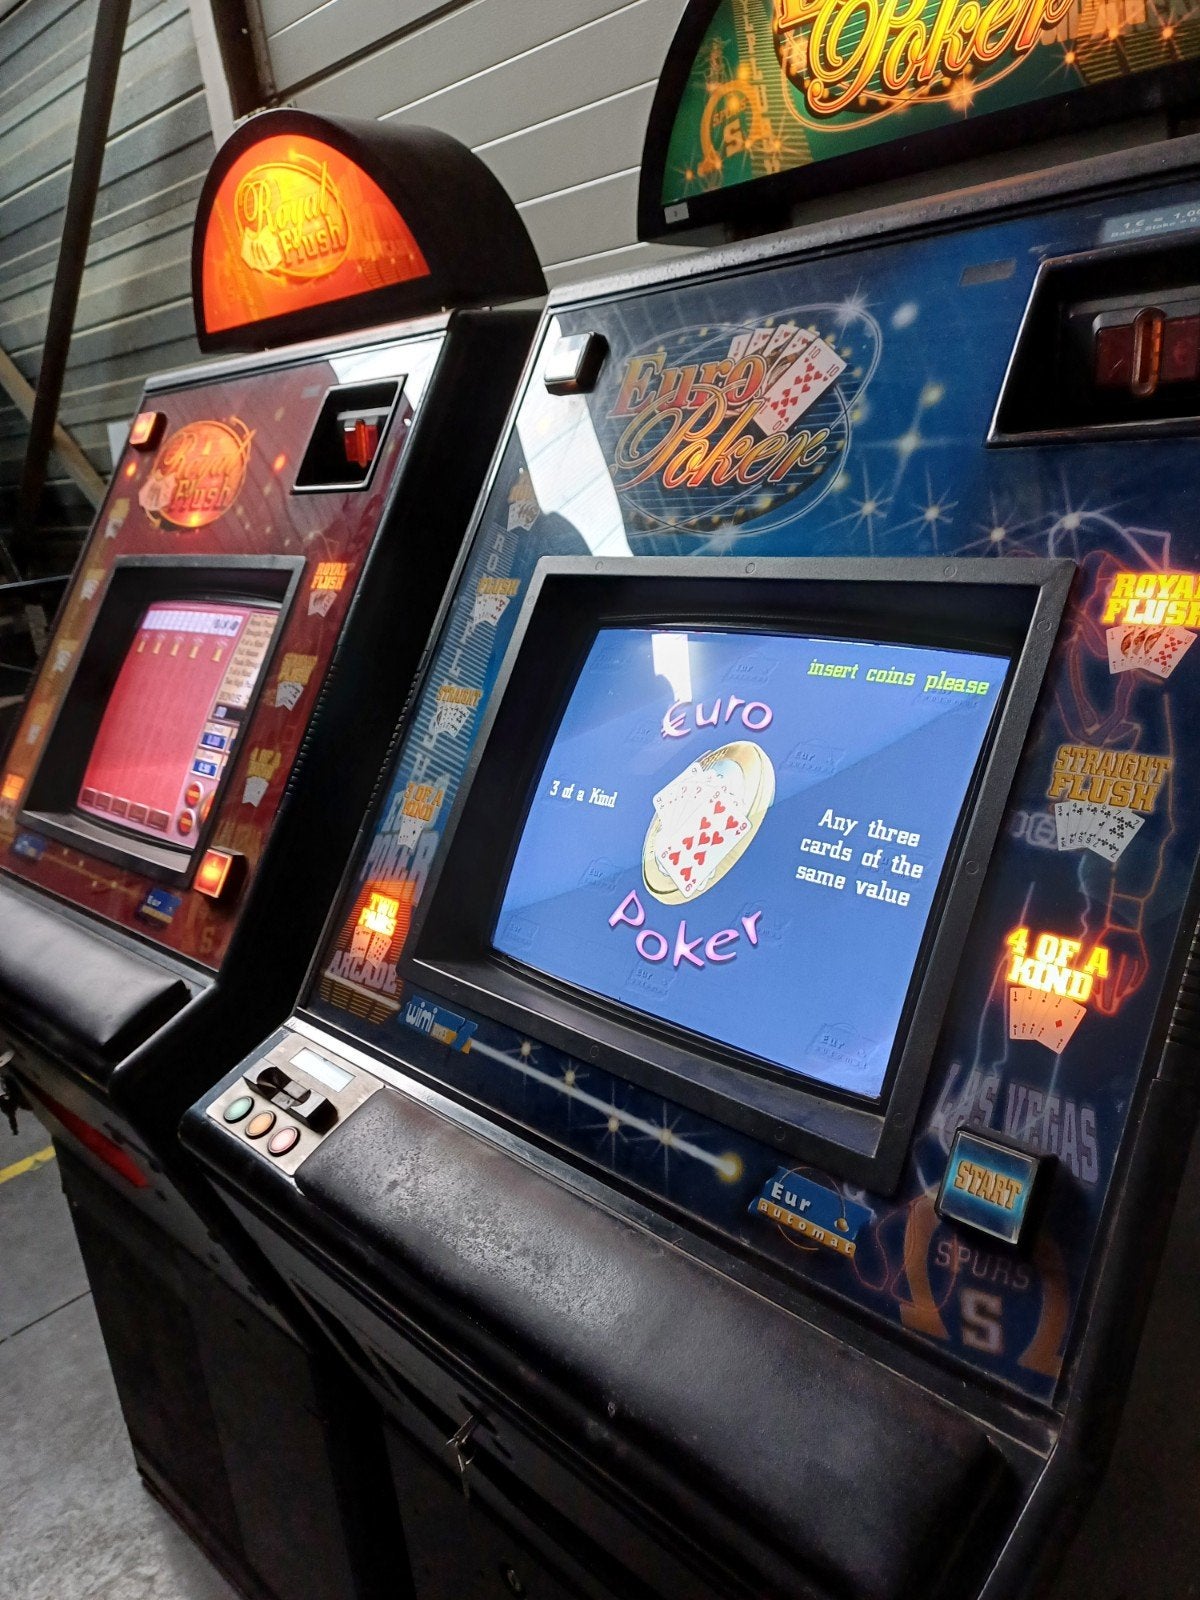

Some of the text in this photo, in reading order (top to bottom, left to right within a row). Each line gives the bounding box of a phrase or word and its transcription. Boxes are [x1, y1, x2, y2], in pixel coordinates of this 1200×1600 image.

[807, 0, 1072, 114] Poker
[606, 352, 767, 419] Euro
[610, 383, 832, 491] Poker
[1112, 574, 1200, 599] ROYA
[807, 659, 990, 695] insert coins please
[1054, 746, 1172, 784] STRAIGHT
[402, 799, 434, 821] KIND
[404, 782, 444, 807] 3 OF A
[549, 780, 618, 808] 3 of a Kind
[1049, 771, 1158, 812] FLUSH
[818, 808, 921, 847] Any three
[800, 837, 924, 879] cards of the
[369, 892, 400, 919] TWO
[795, 865, 911, 907] same value
[608, 889, 762, 967] Poker
[1007, 928, 1110, 979] 4 OF A
[1006, 954, 1094, 1002] KIND
[405, 1001, 438, 1033] wimi
[1003, 1082, 1099, 1184] VEGAS
[771, 1181, 811, 1211] Eur
[954, 1159, 1023, 1210] START
[760, 1201, 854, 1255] automat
[936, 1241, 1030, 1291] SPURS
[961, 1287, 1003, 1355] S
